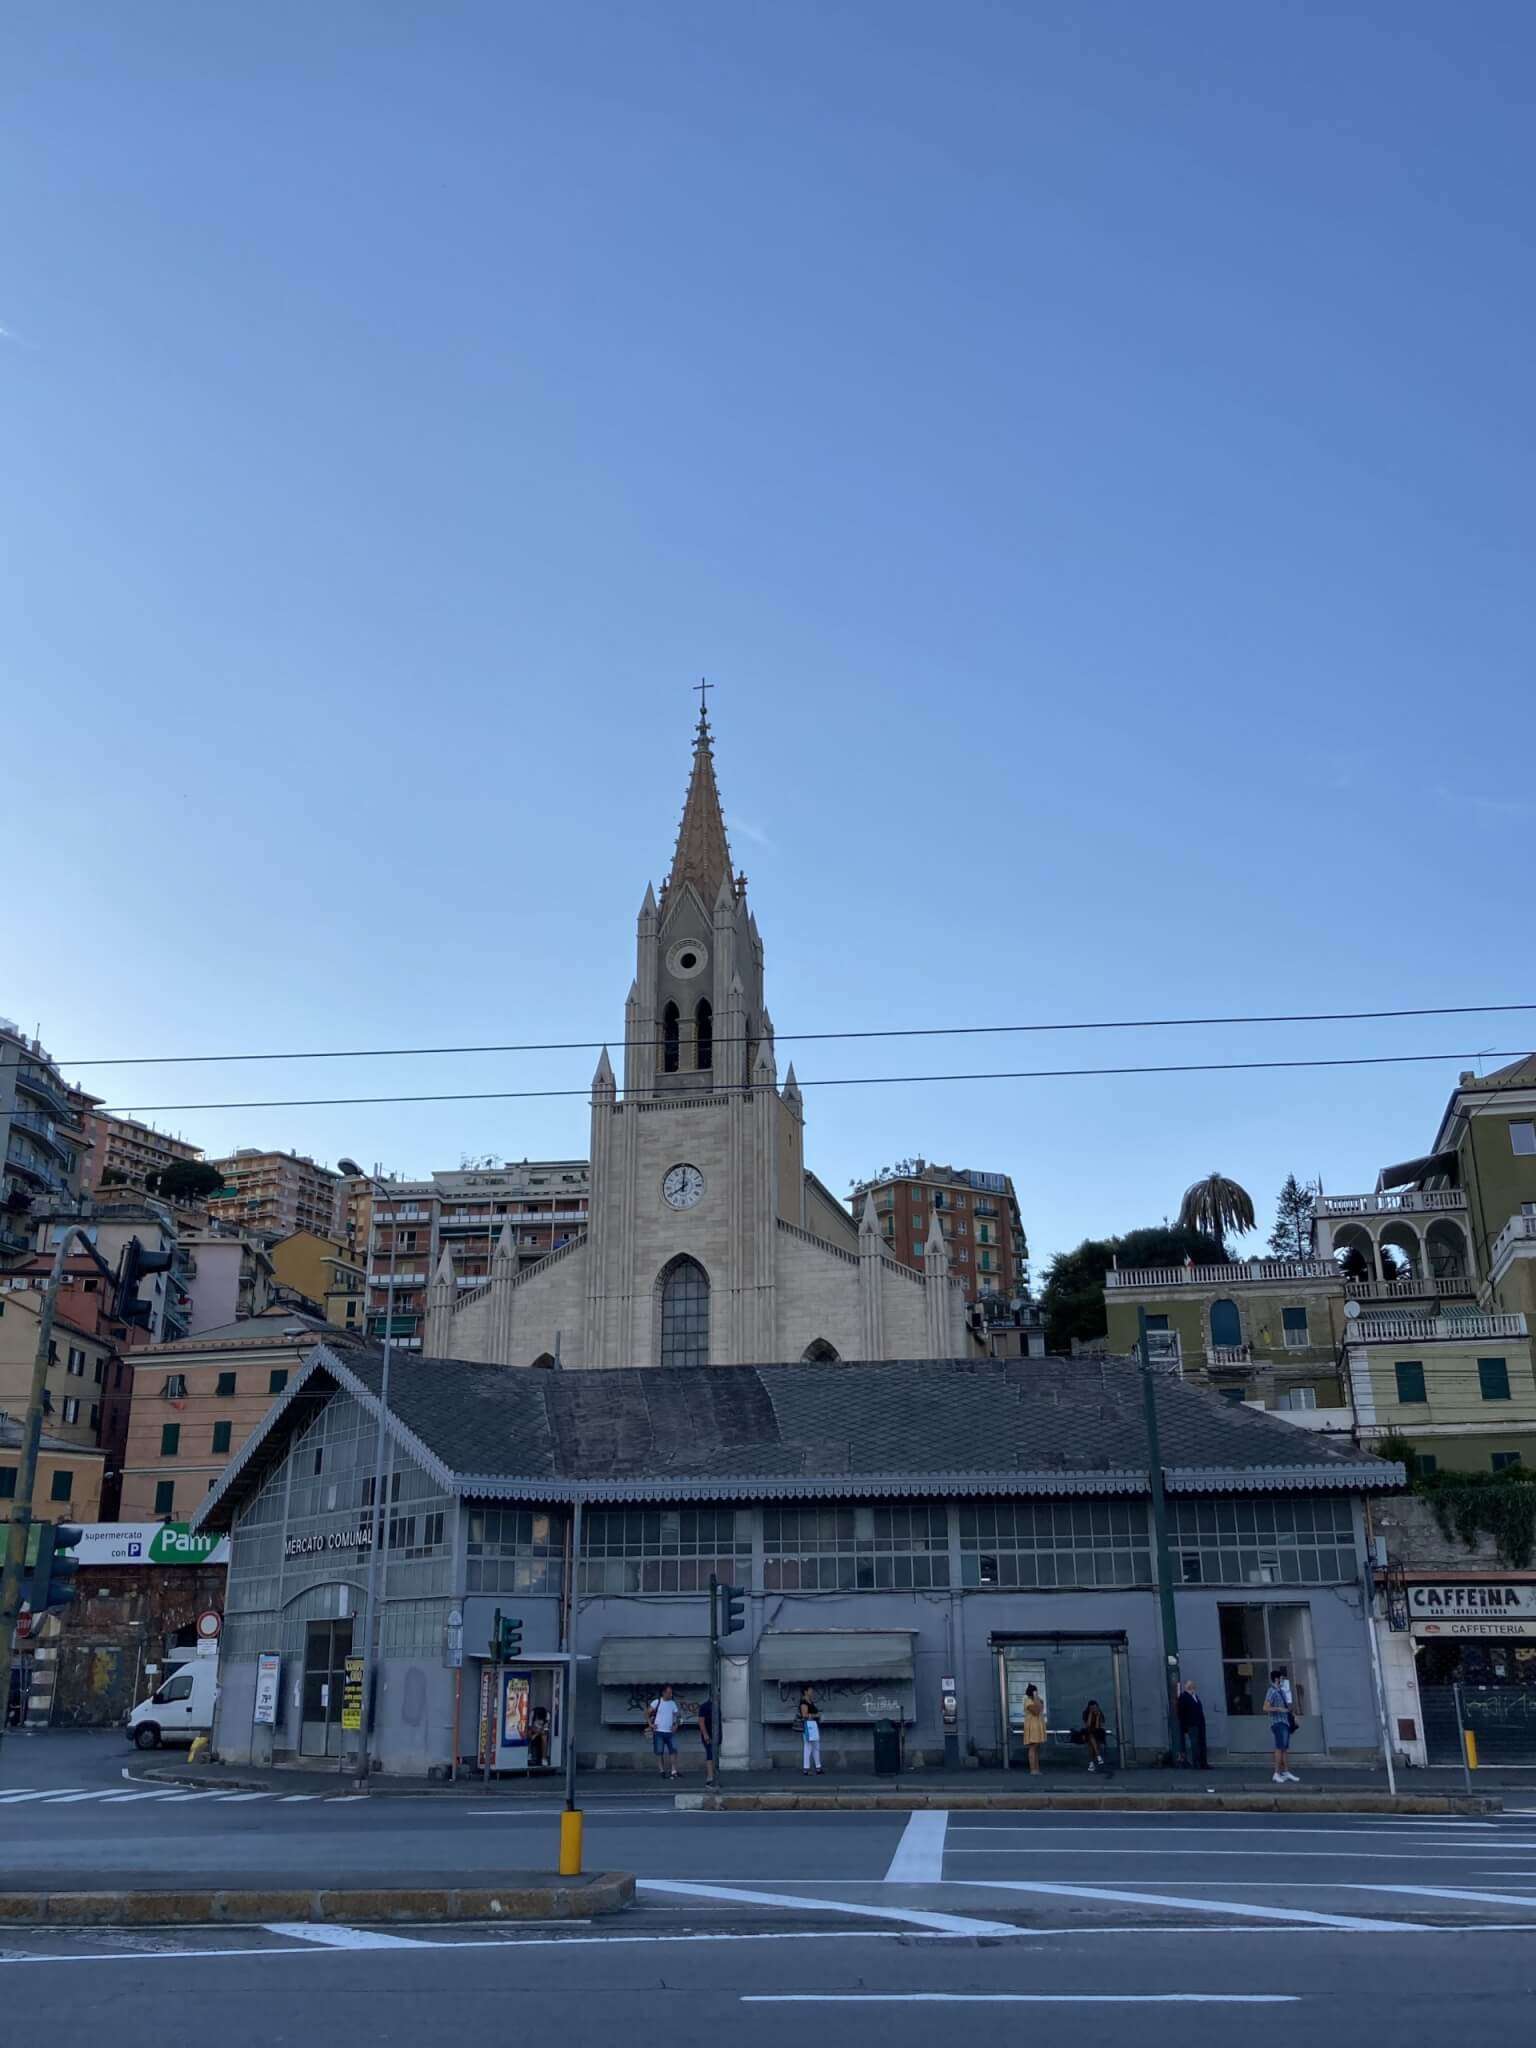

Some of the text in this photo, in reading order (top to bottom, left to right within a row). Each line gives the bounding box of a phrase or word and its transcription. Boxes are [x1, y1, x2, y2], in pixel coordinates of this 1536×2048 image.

[85, 1531, 143, 1541] supermercato
[161, 1530, 212, 1551] Pam
[285, 1528, 375, 1554] MERCATO COMUNAL
[111, 1549, 126, 1557] con
[1451, 1624, 1526, 1634] CAFFETTERIA
